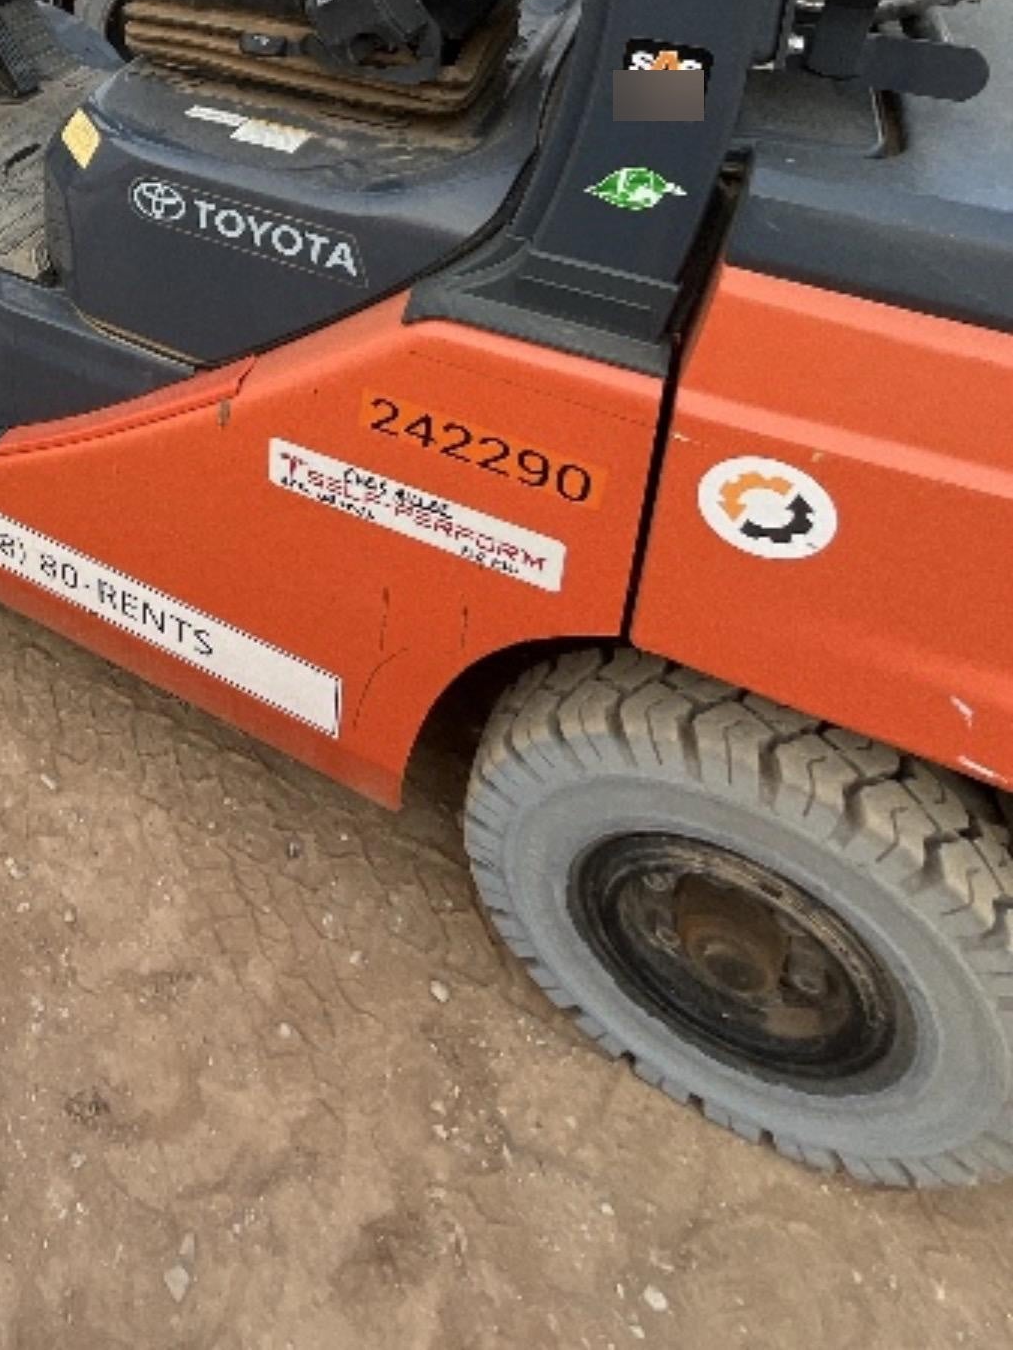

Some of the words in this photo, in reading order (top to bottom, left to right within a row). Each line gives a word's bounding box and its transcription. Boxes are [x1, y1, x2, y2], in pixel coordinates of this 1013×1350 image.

[193, 199, 357, 277] TOYOTA
[369, 397, 592, 503] 242290
[39, 553, 214, 657] 80-RENTS
